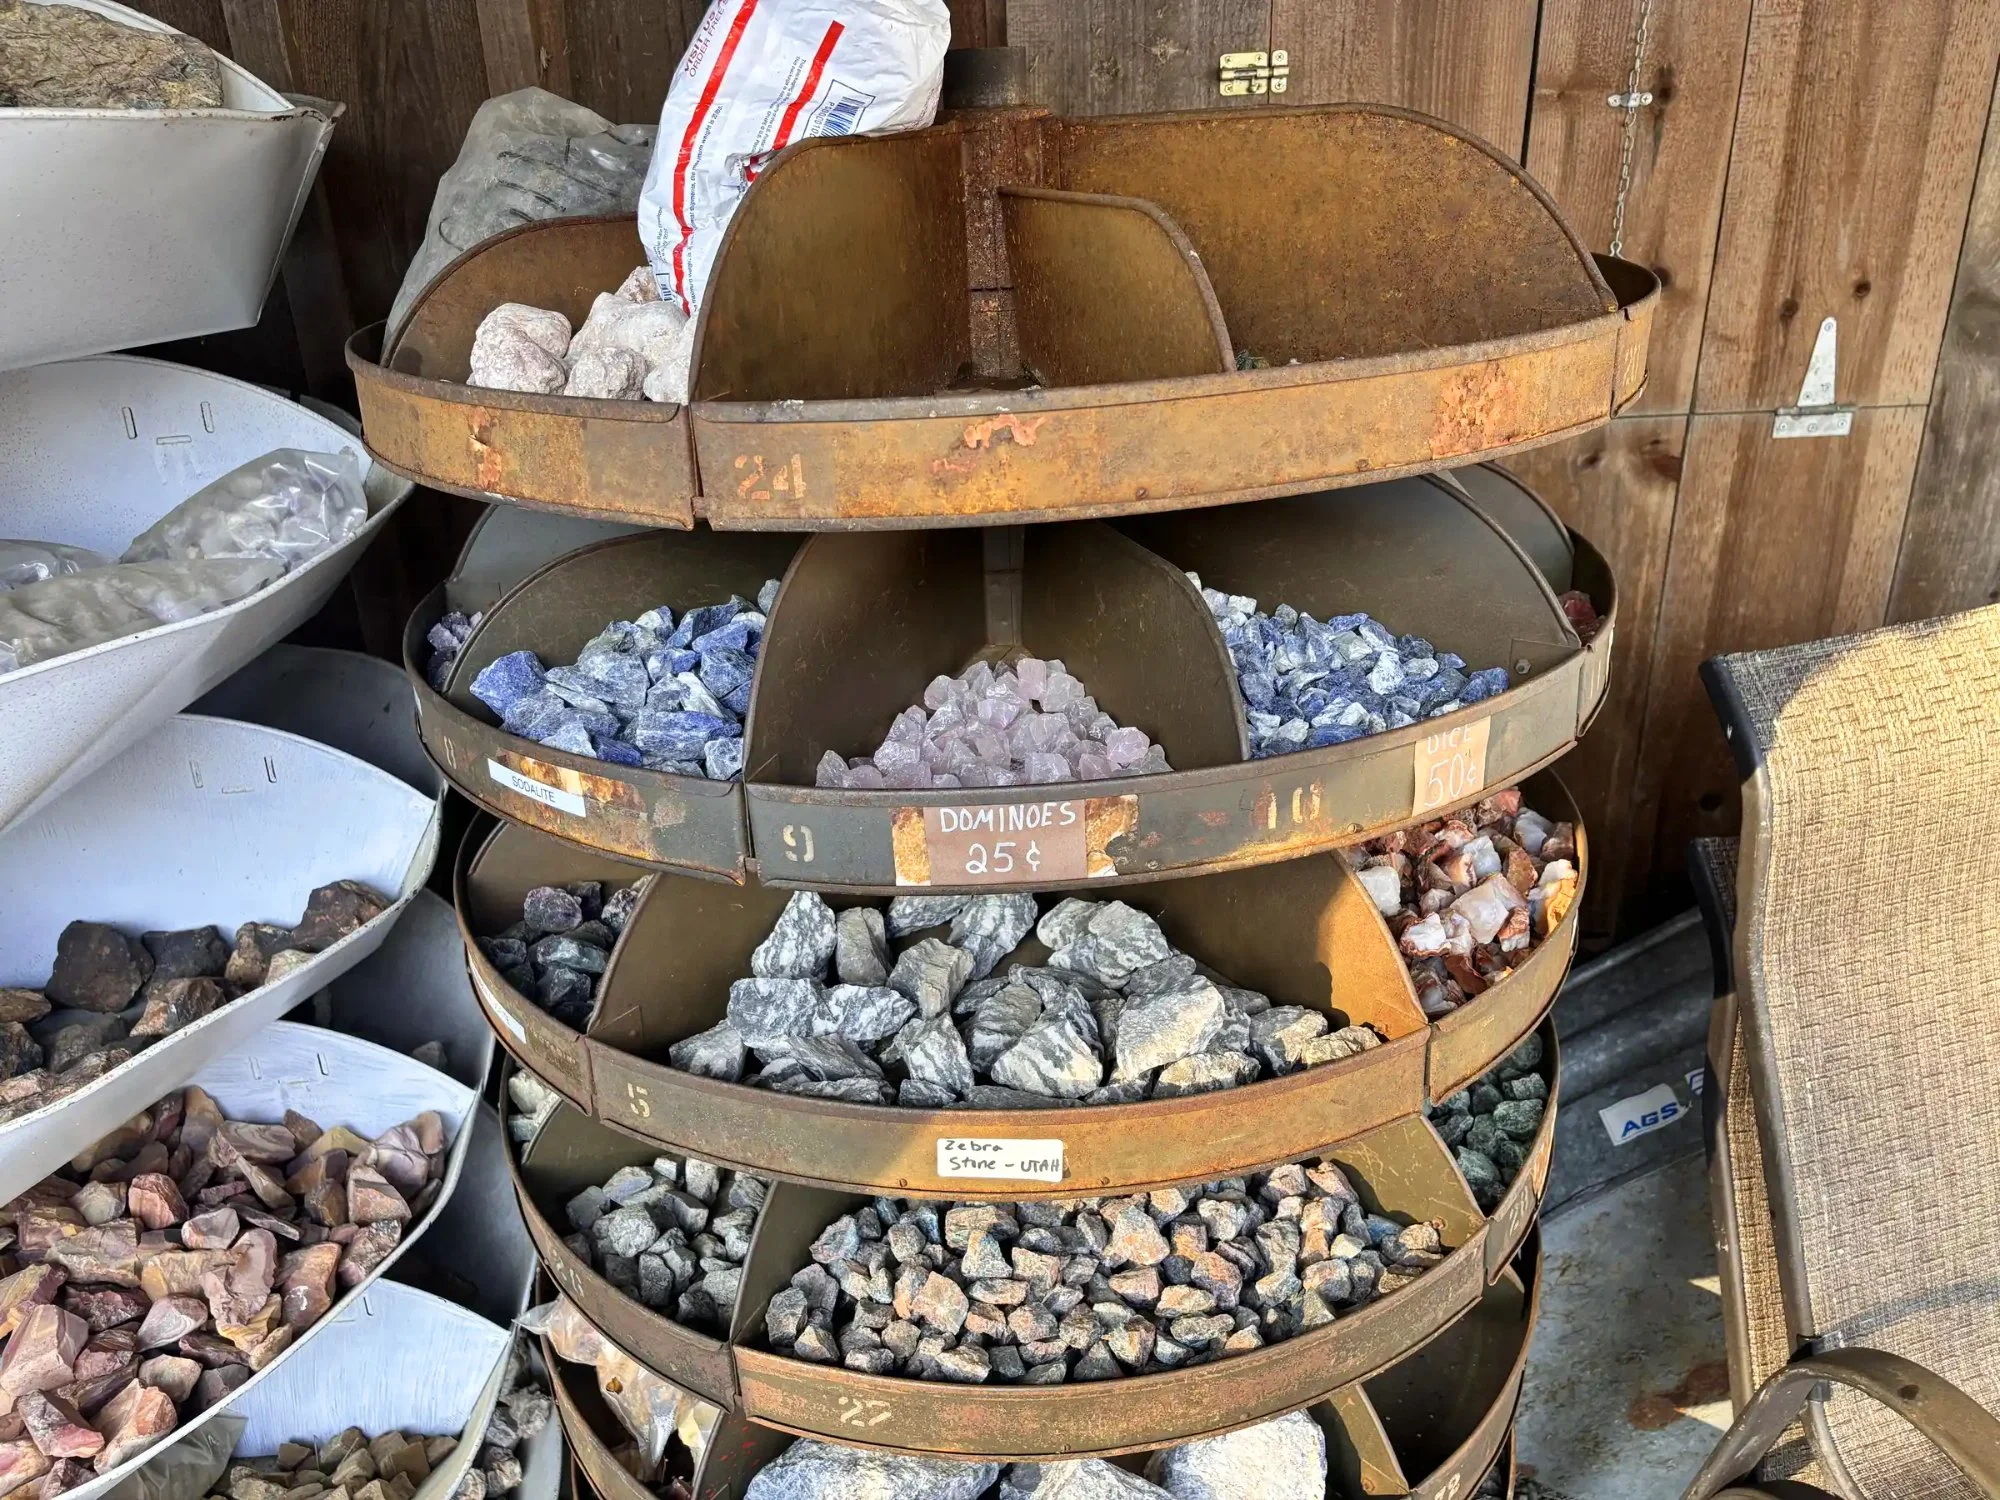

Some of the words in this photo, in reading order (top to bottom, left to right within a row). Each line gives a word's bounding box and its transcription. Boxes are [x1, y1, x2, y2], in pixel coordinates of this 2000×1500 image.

[685, 35, 703, 71] VISIT
[703, 11, 715, 31] US
[690, 38, 711, 77] ORDER
[708, 8, 725, 37] FREE
[734, 452, 807, 501] 24
[1427, 725, 1472, 755] DICE
[511, 775, 556, 803] SODALITE
[939, 802, 1077, 833] DOMINOES
[782, 824, 815, 863] 9
[1621, 1102, 1679, 1138] AGS
[944, 1139, 1004, 1153] Zebra
[949, 1156, 997, 1171] Stone
[1020, 1158, 1060, 1174] UTAH
[838, 1396, 892, 1428] 27
